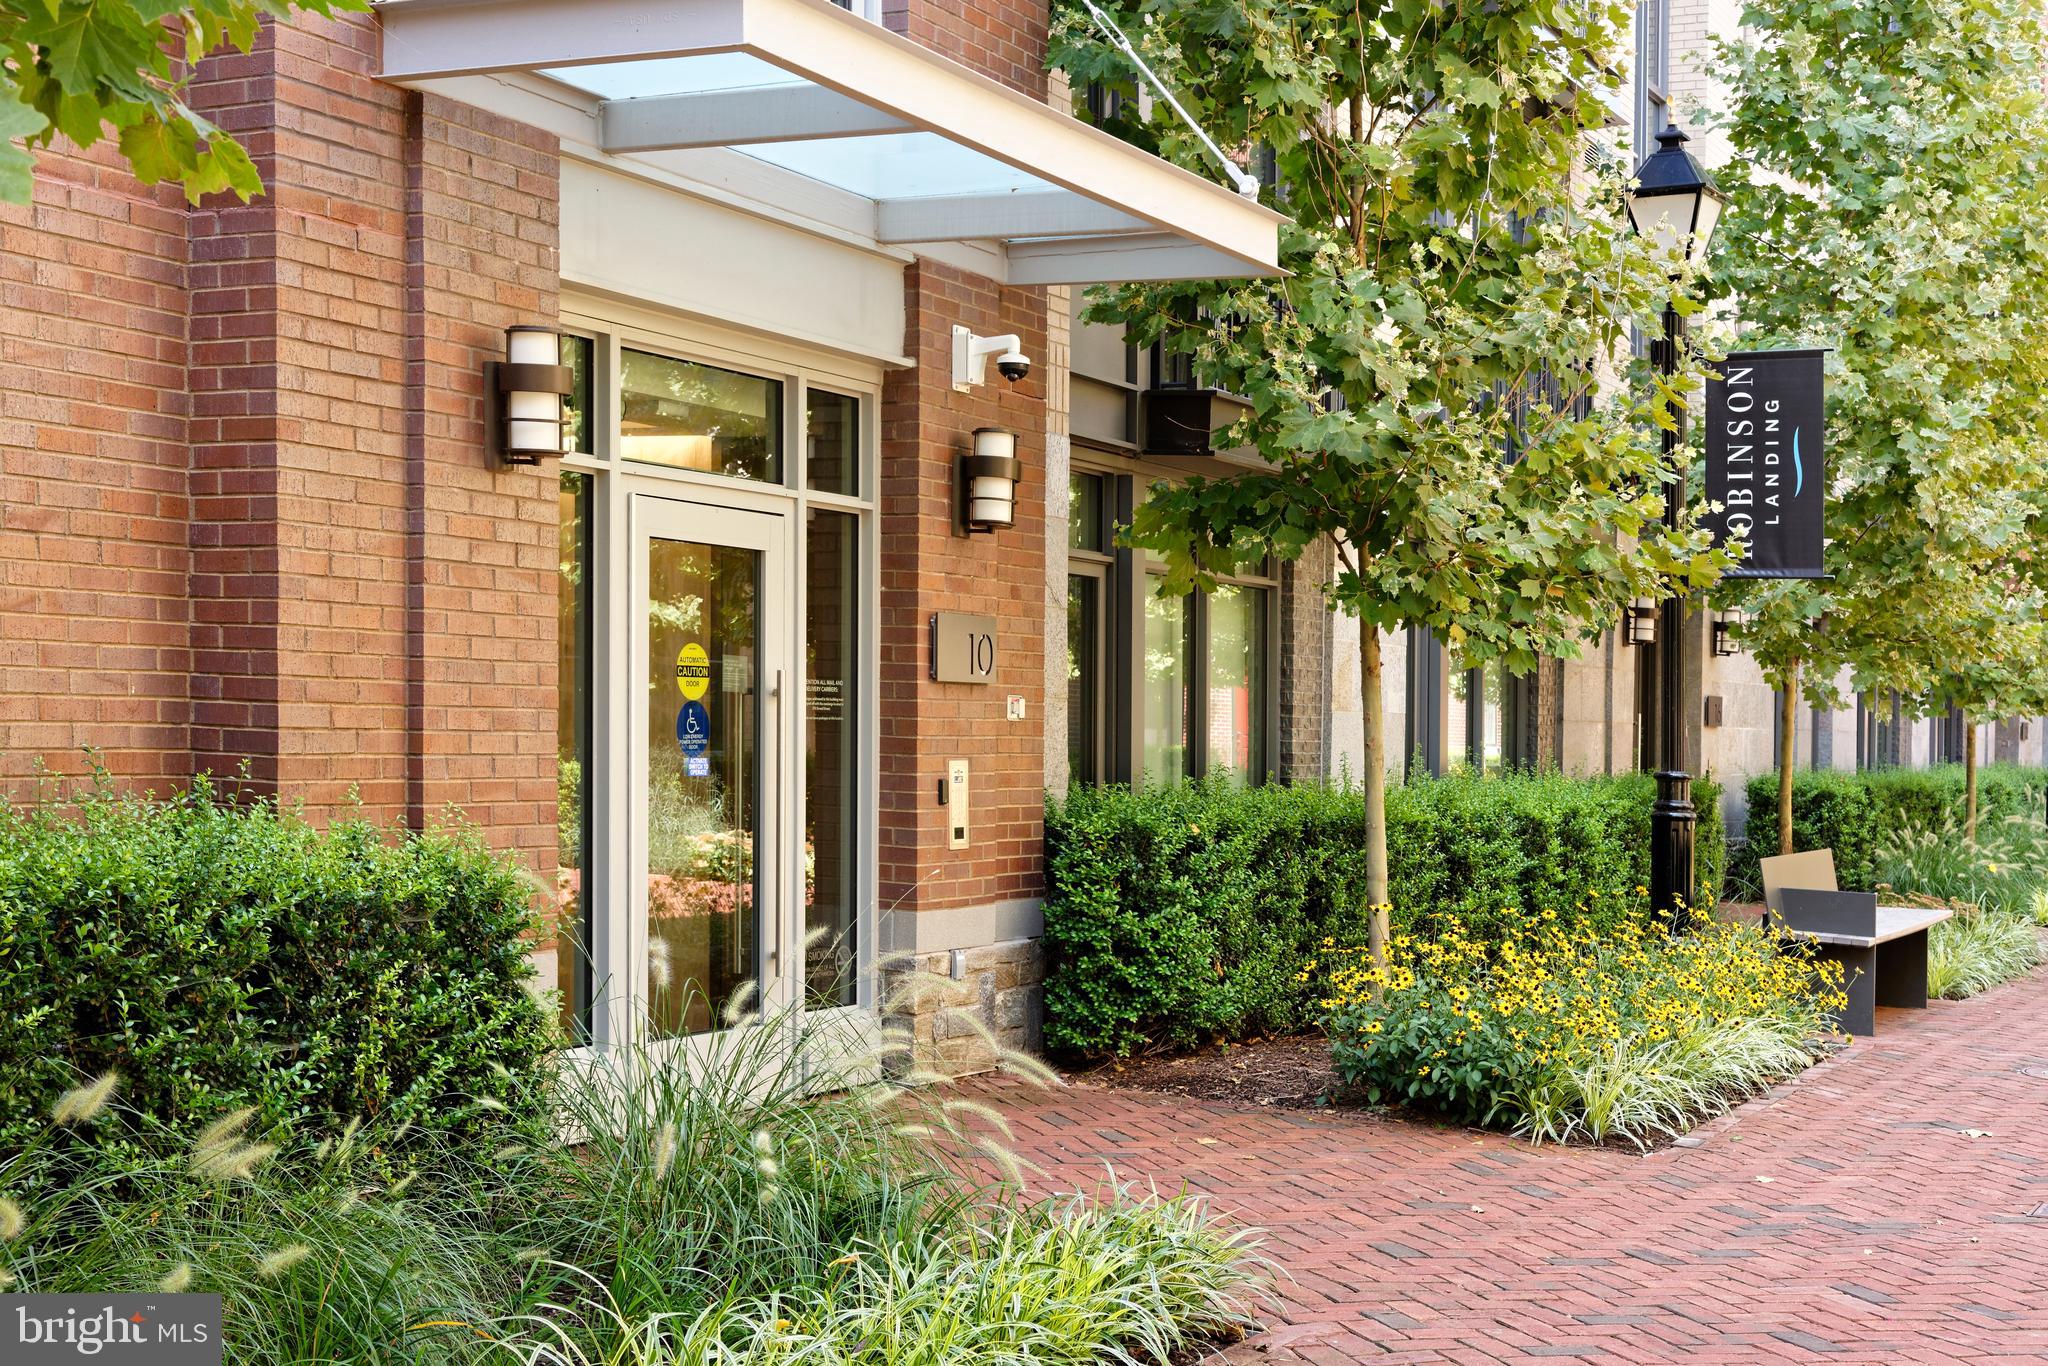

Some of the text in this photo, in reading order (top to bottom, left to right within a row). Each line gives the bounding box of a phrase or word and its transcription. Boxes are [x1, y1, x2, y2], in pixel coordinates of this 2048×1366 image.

[1765, 400, 1780, 525] LANDING
[968, 633, 993, 676] 10
[677, 666, 709, 677] CAUTION
[808, 950, 835, 961] SMOKING
